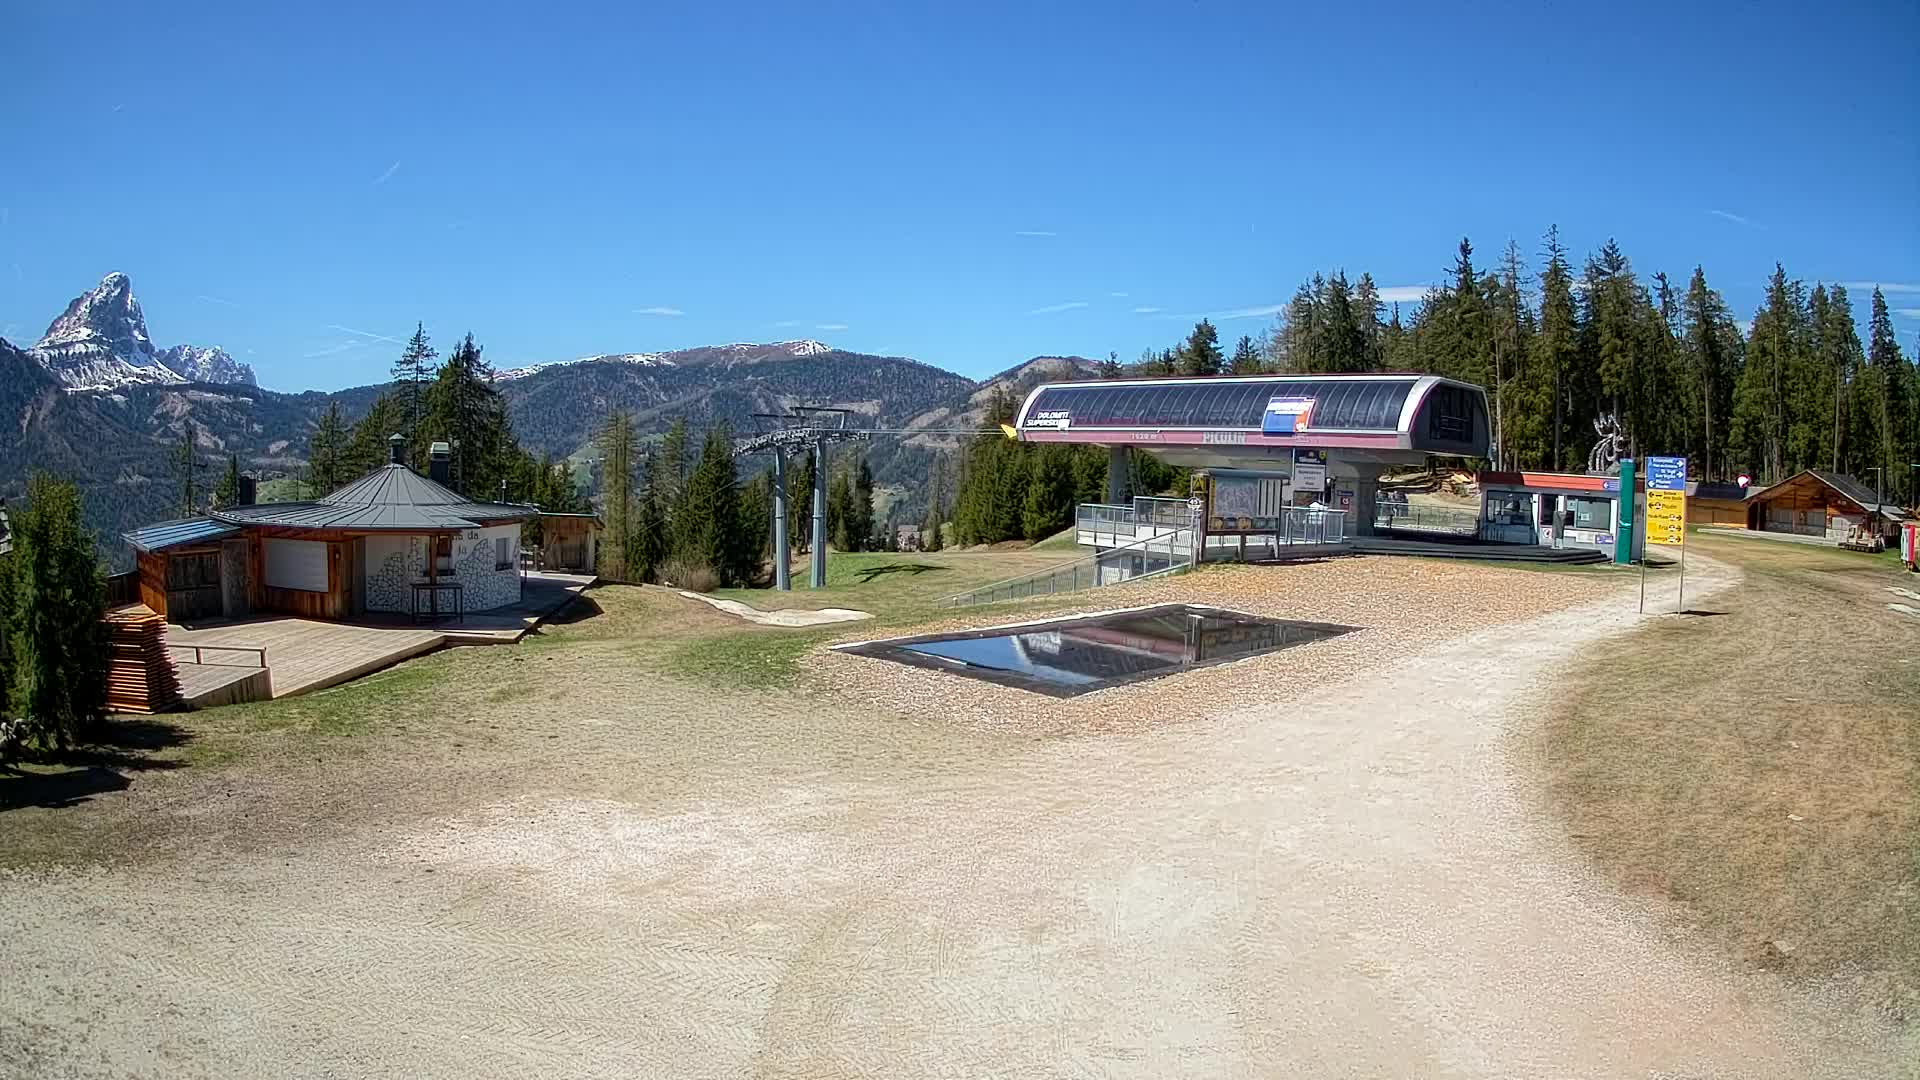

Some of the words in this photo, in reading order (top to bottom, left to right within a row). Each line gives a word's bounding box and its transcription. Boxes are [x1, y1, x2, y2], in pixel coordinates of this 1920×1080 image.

[1037, 411, 1069, 419] DOLOMITI
[1203, 431, 1246, 444] PICULIN
[467, 531, 478, 540] da
